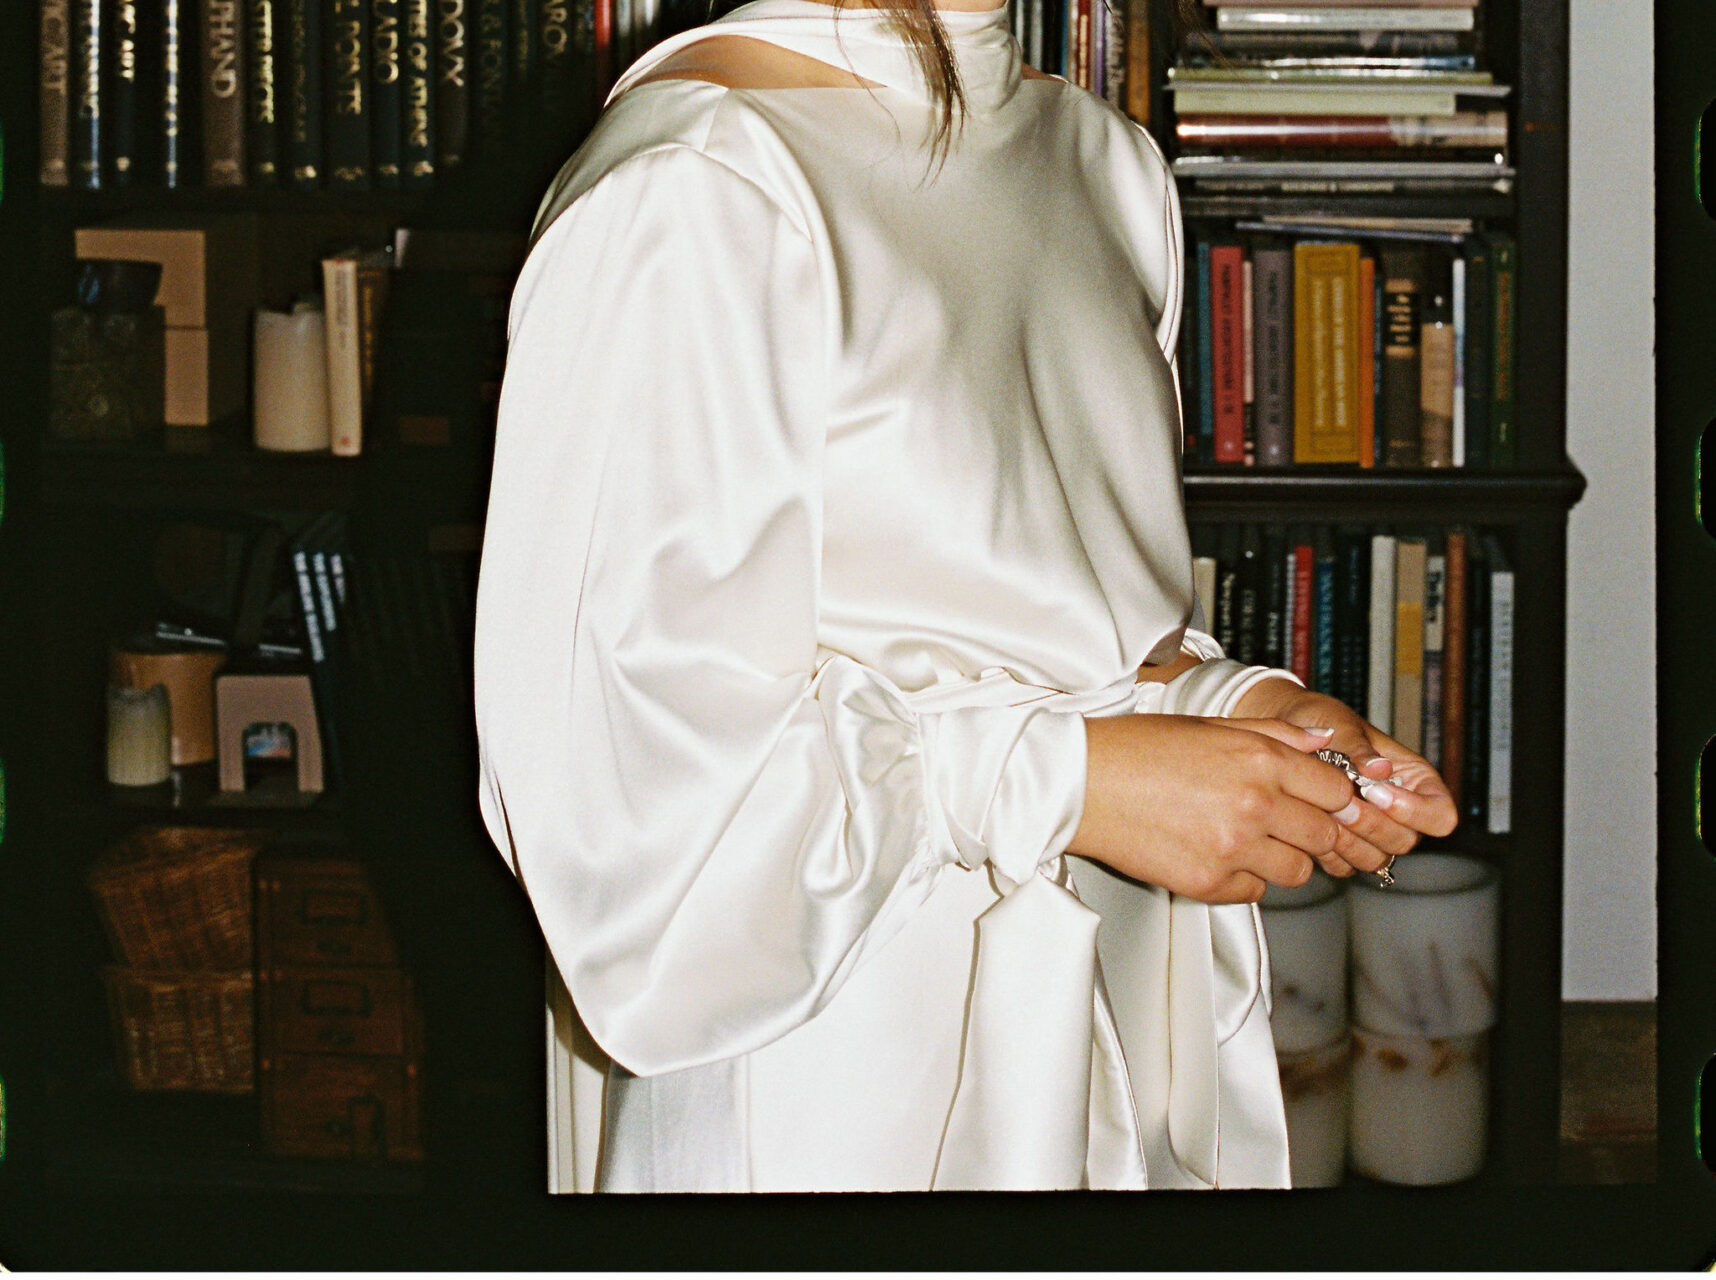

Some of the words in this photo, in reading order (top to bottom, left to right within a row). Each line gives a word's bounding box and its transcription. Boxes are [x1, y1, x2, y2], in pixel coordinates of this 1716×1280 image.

[480, 14, 502, 32] &
[335, 20, 362, 116] POINTS
[408, 41, 427, 72] OF
